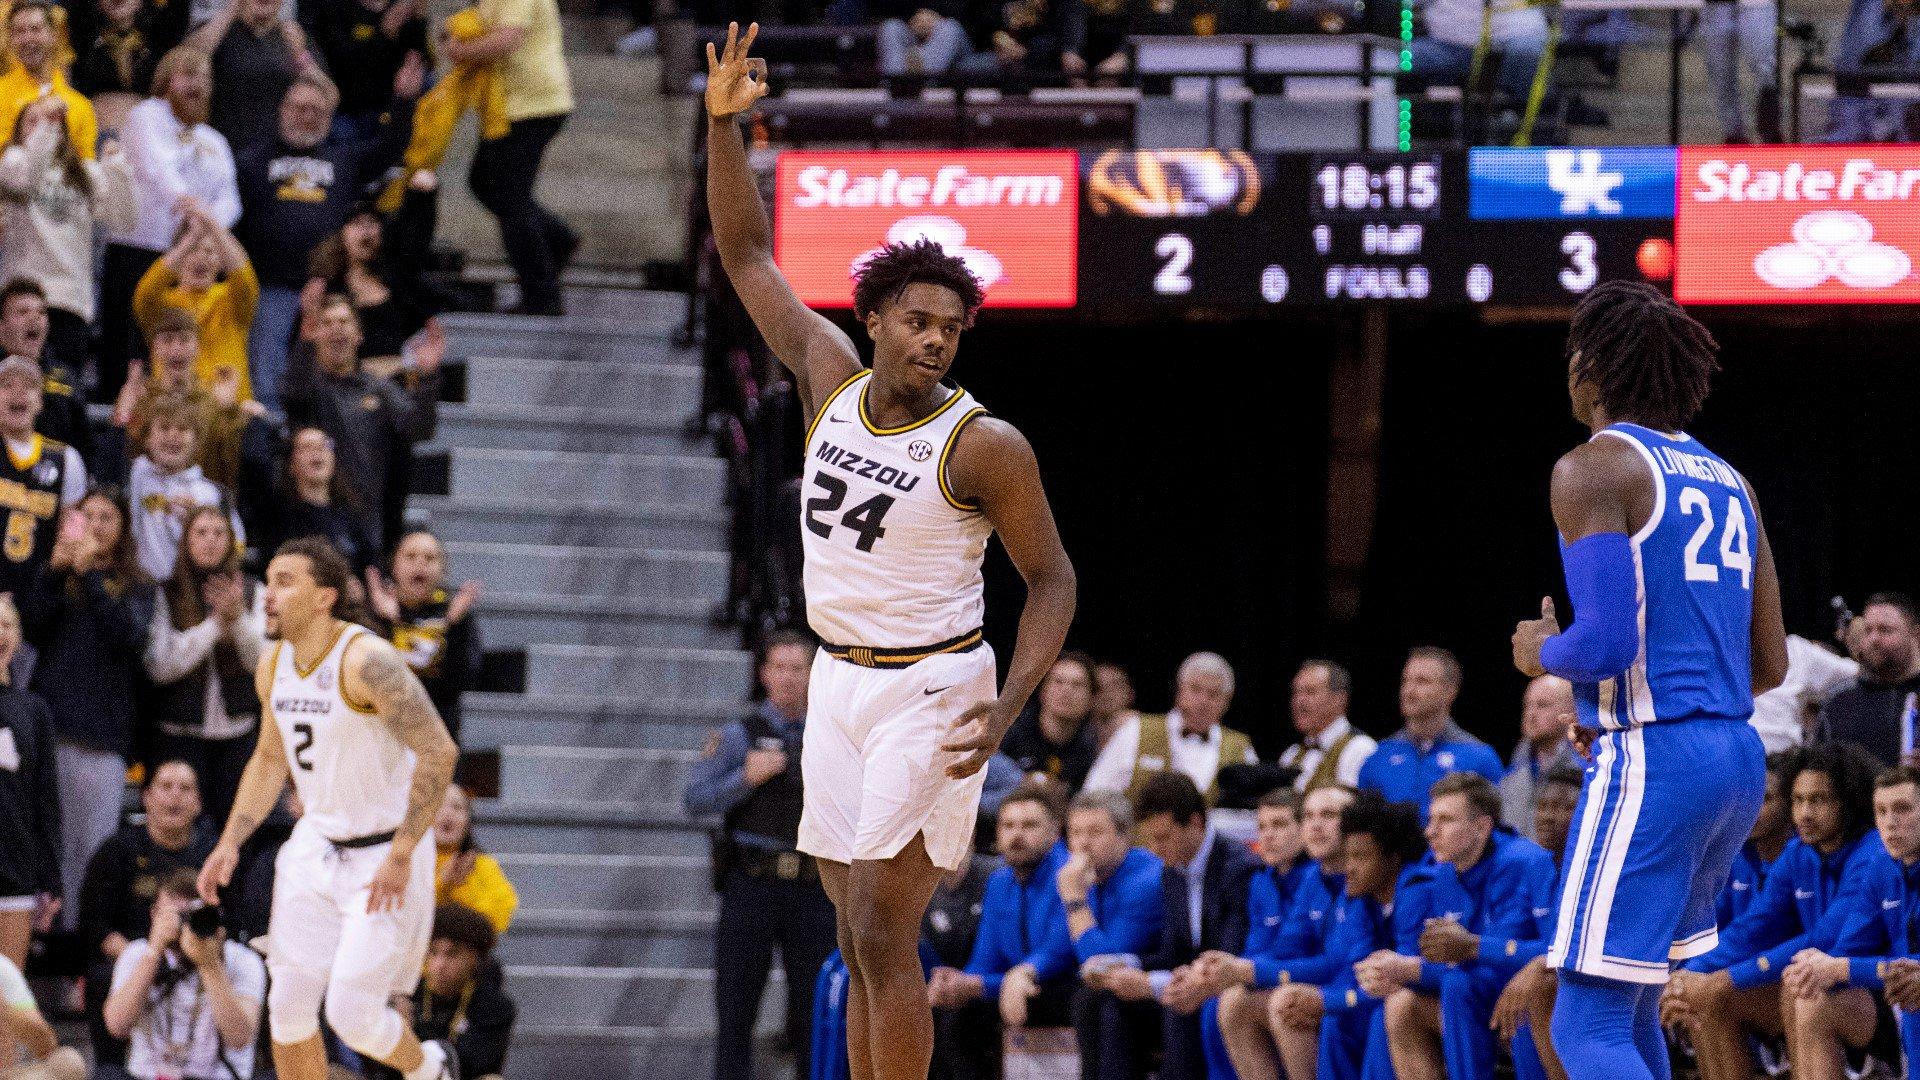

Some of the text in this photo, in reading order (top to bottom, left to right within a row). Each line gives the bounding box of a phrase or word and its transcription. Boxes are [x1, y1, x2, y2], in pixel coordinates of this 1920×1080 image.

[1314, 162, 1438, 209] 18:15
[1153, 233, 1194, 294] 2
[1313, 224, 1331, 254] 1
[1558, 231, 1599, 293] 3
[1261, 263, 1494, 302] 0 FOULS 0
[815, 441, 920, 493] MIZZOU
[806, 470, 896, 553] 24
[1679, 487, 1752, 590] 24
[275, 698, 332, 714] MIZZOU
[294, 723, 314, 771] 2
